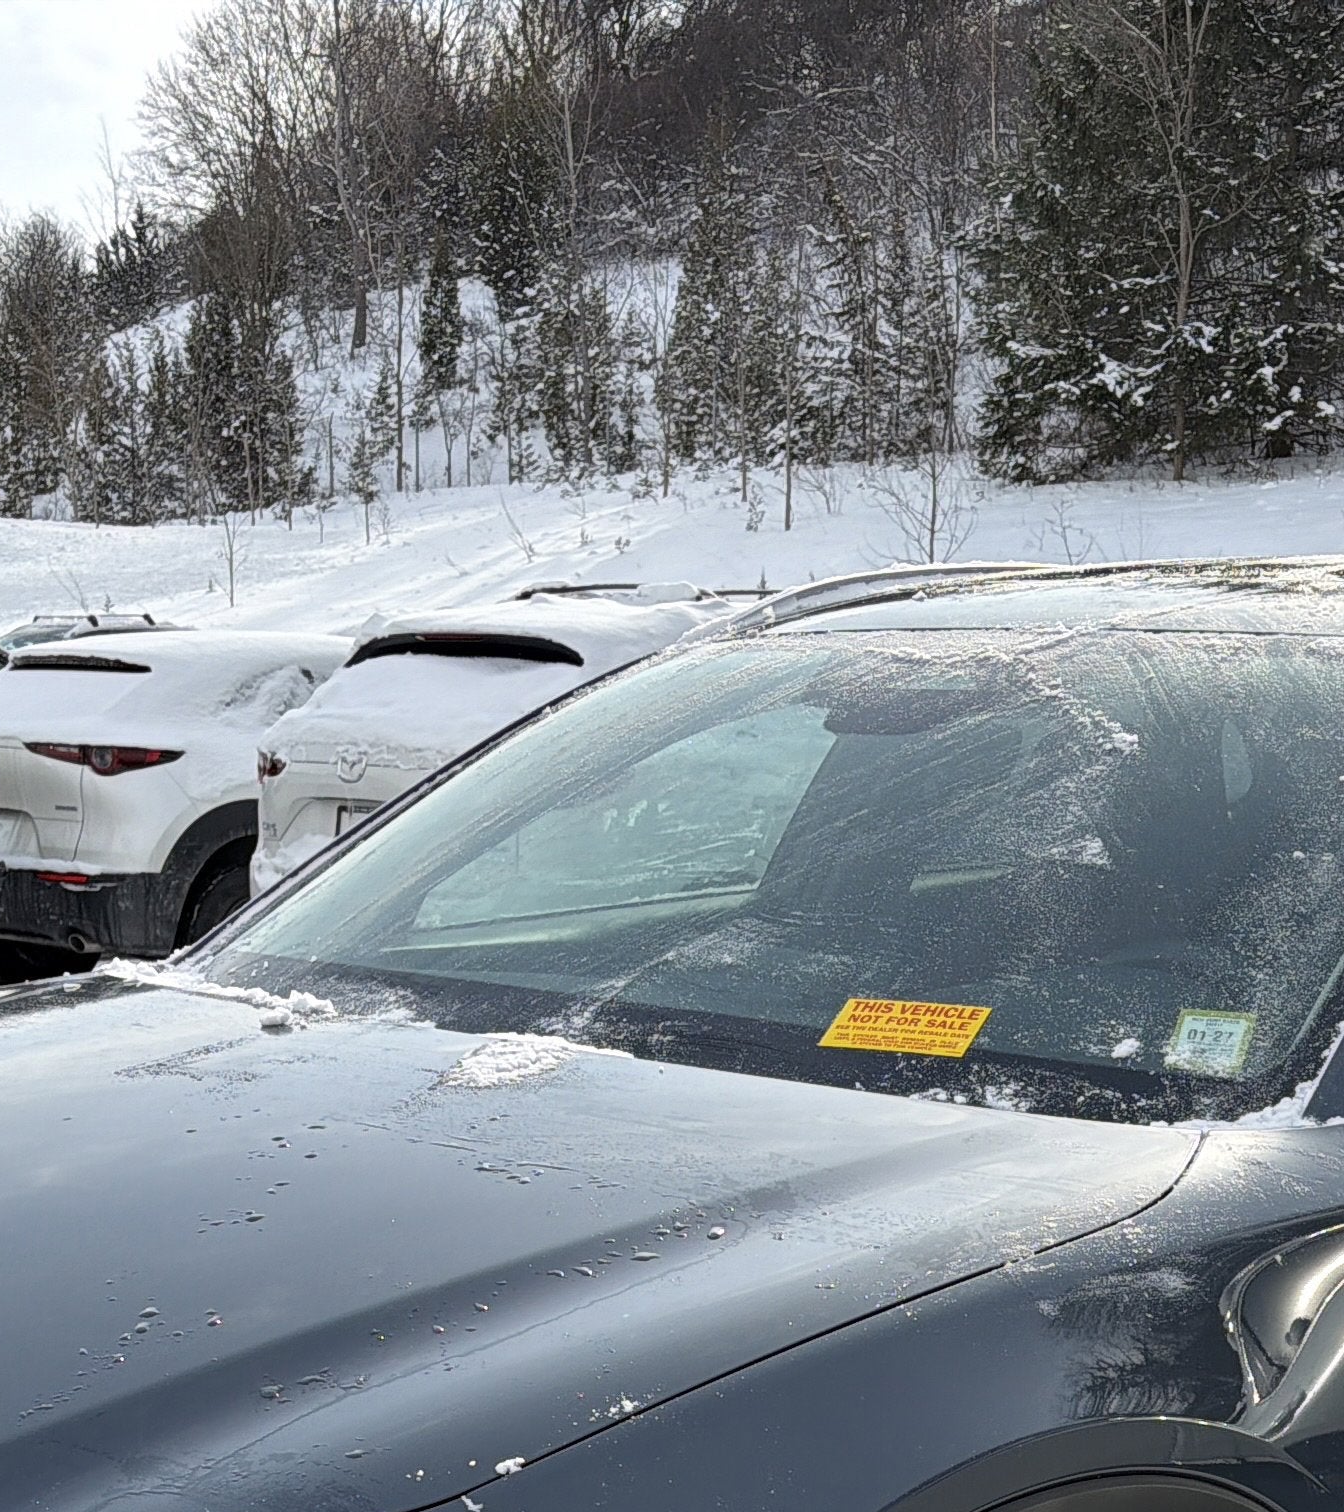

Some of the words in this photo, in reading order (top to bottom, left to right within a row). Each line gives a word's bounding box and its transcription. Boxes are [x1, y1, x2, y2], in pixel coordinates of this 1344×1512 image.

[852, 1001, 895, 1013] THIS
[900, 1004, 984, 1020] VEHICLE
[848, 1014, 883, 1023] NOT
[885, 1016, 918, 1026] FOR
[925, 1019, 971, 1030] SALE
[1186, 1028, 1234, 1043] 01-27
